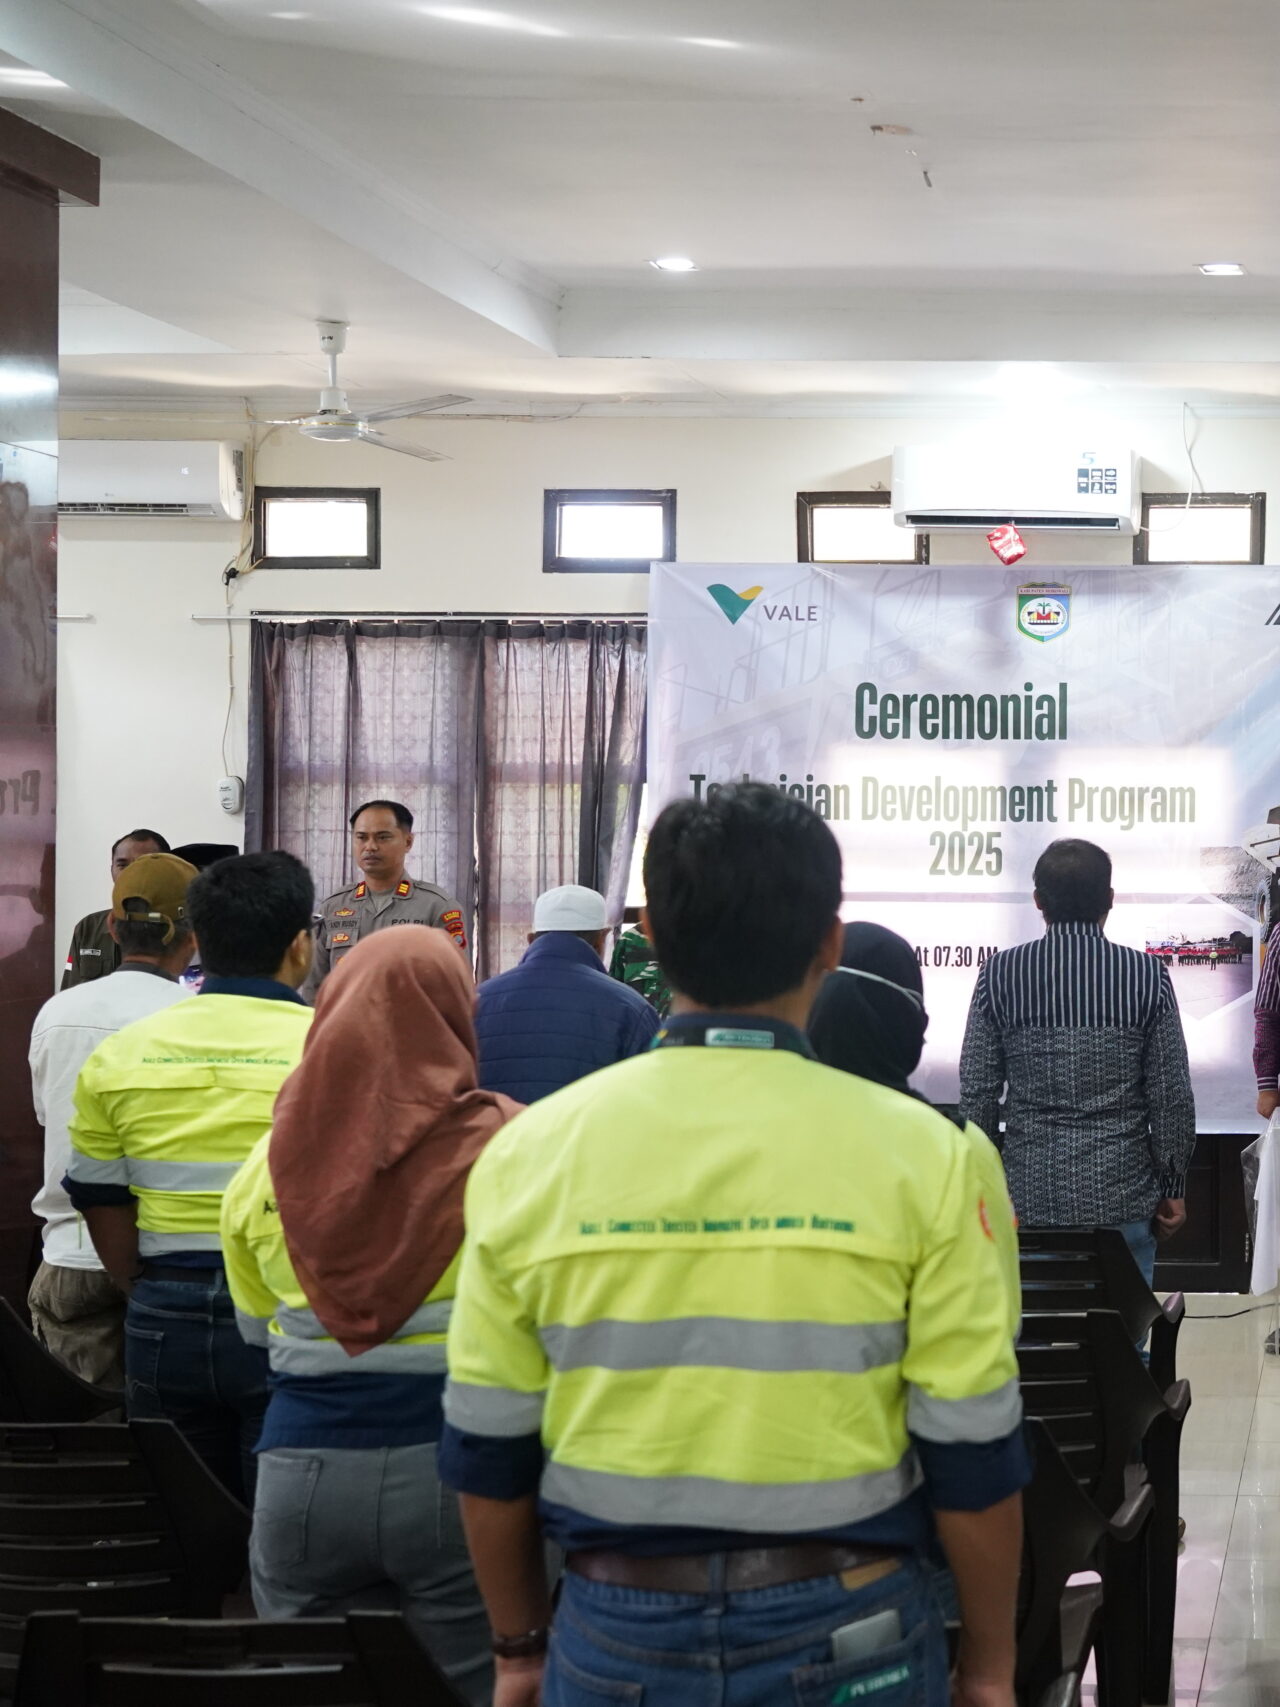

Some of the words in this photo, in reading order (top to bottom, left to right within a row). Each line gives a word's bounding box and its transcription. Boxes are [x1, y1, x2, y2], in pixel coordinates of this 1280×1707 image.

[763, 604, 818, 621] VALE
[854, 681, 1068, 741] Ceremonial
[861, 775, 1058, 831] Development
[1067, 777, 1196, 831] Program
[929, 831, 1003, 877] 2025
[915, 945, 930, 967] At
[933, 945, 973, 968] 07.30
